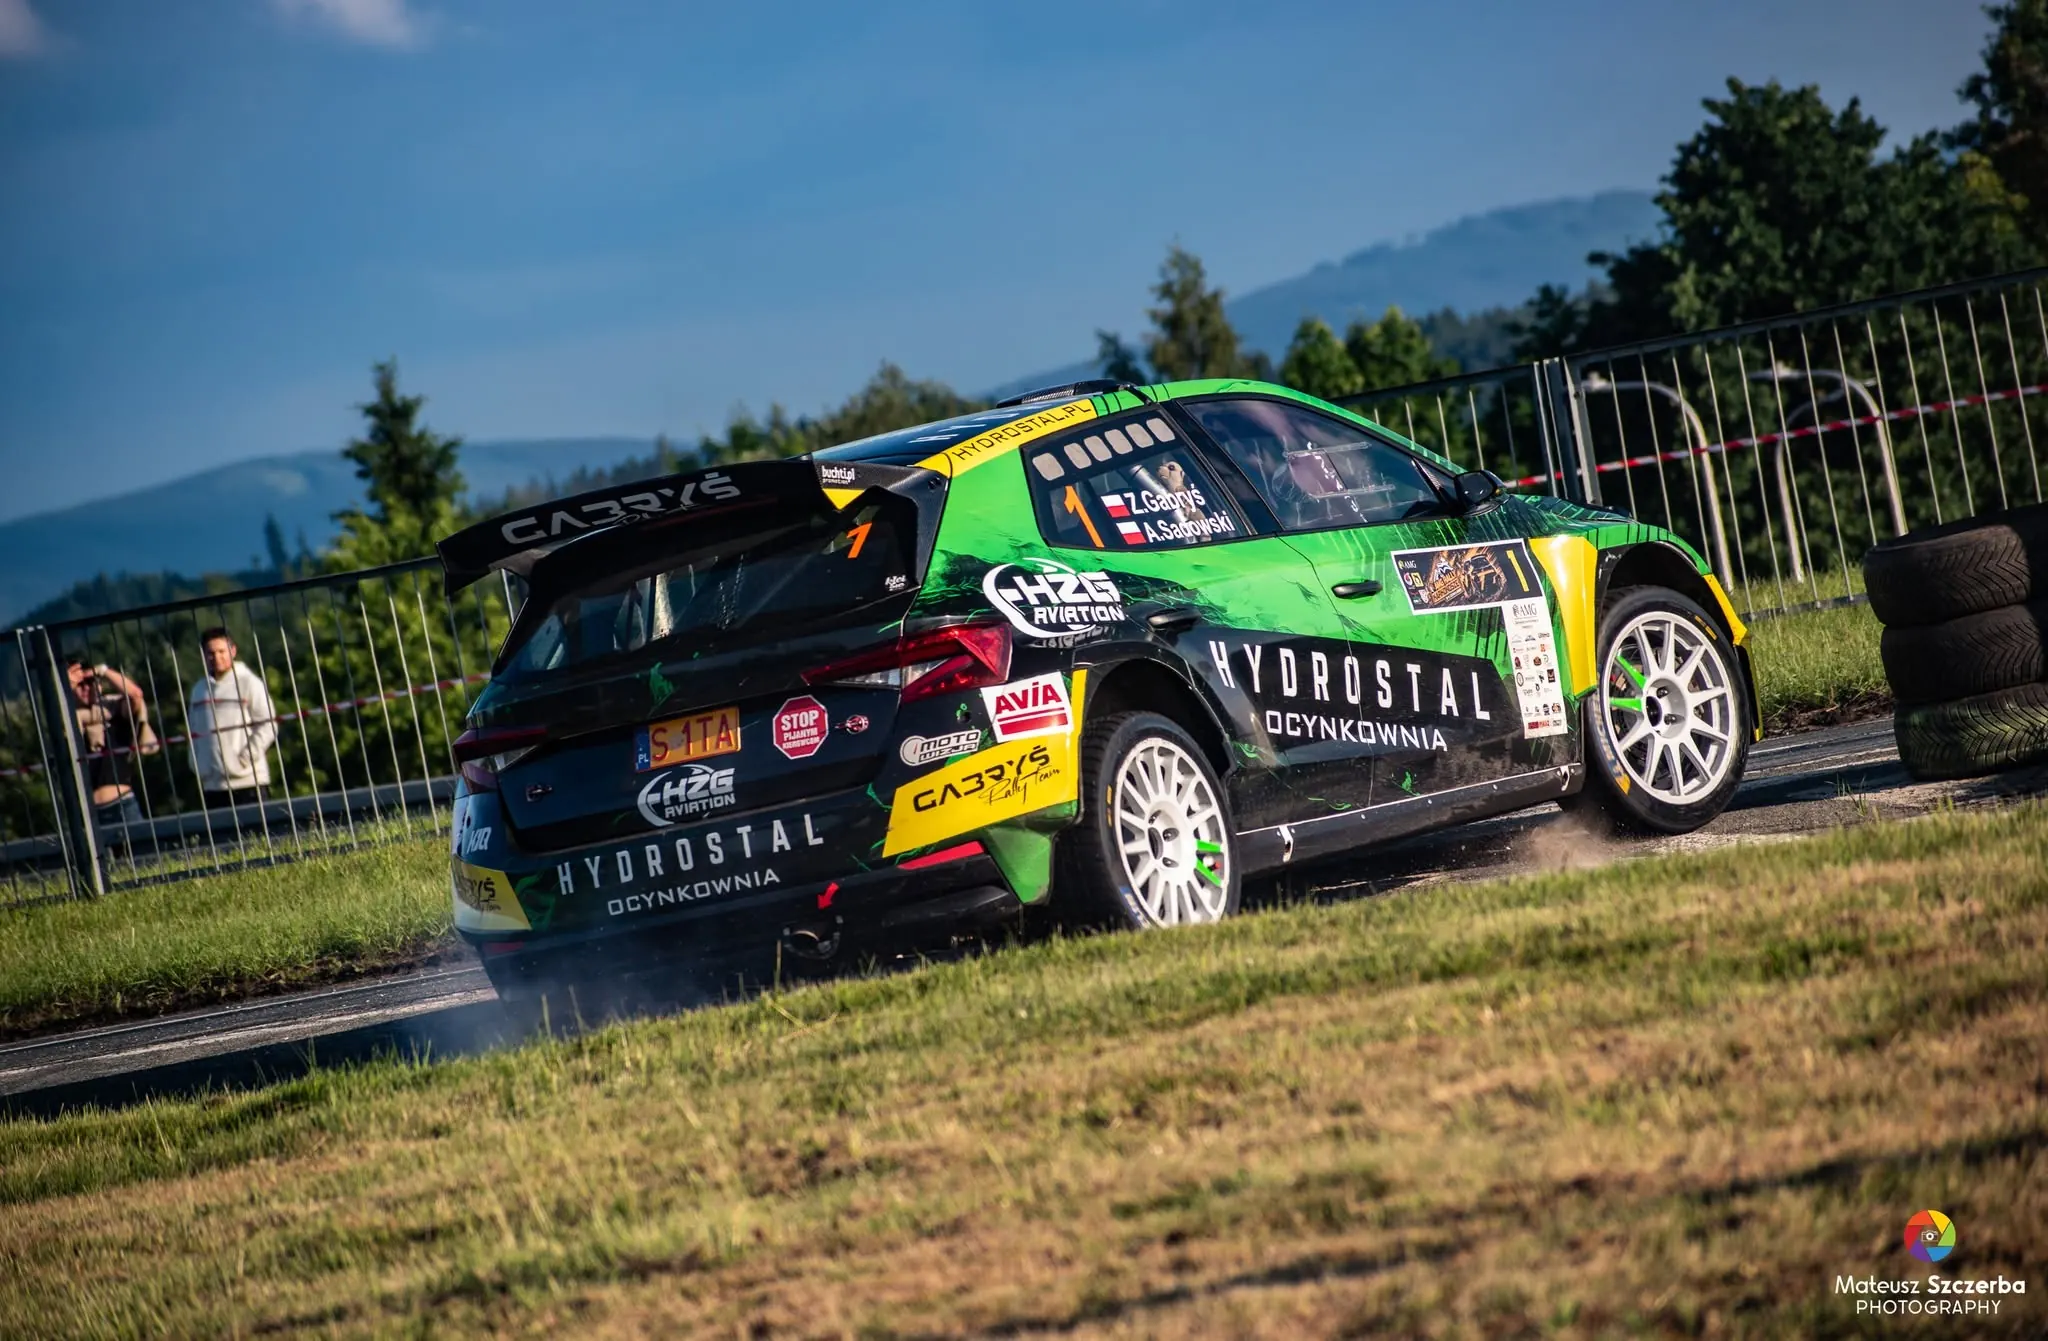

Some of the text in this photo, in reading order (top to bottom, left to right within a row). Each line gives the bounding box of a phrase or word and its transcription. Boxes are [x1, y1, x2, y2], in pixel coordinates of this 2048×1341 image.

[952, 402, 1092, 461] HYDROSTAL.PL
[1064, 485, 1105, 548] 1
[1123, 483, 1206, 515] Z.Gabryś
[846, 522, 873, 559] 1
[1142, 510, 1236, 544] A.Sadowski
[1505, 549, 1530, 592] 1
[1012, 571, 1121, 606] HZG
[1033, 605, 1126, 625] AVIATION
[995, 682, 1062, 714] AVIA
[1209, 640, 1491, 721] HYDROSTAL
[781, 710, 819, 732] STOP
[783, 727, 818, 741] PIJANYM
[1265, 710, 1448, 752] OCYNKOWNIA
[638, 752, 649, 763] PL
[651, 727, 669, 761] S
[920, 731, 979, 754] MOTO
[662, 767, 736, 807] HZG
[912, 745, 1050, 812] GABRYŚ
[664, 793, 736, 819] AVIATION
[557, 813, 824, 896] HYDROSTAL
[607, 868, 781, 916] OCYNKOWNIA
